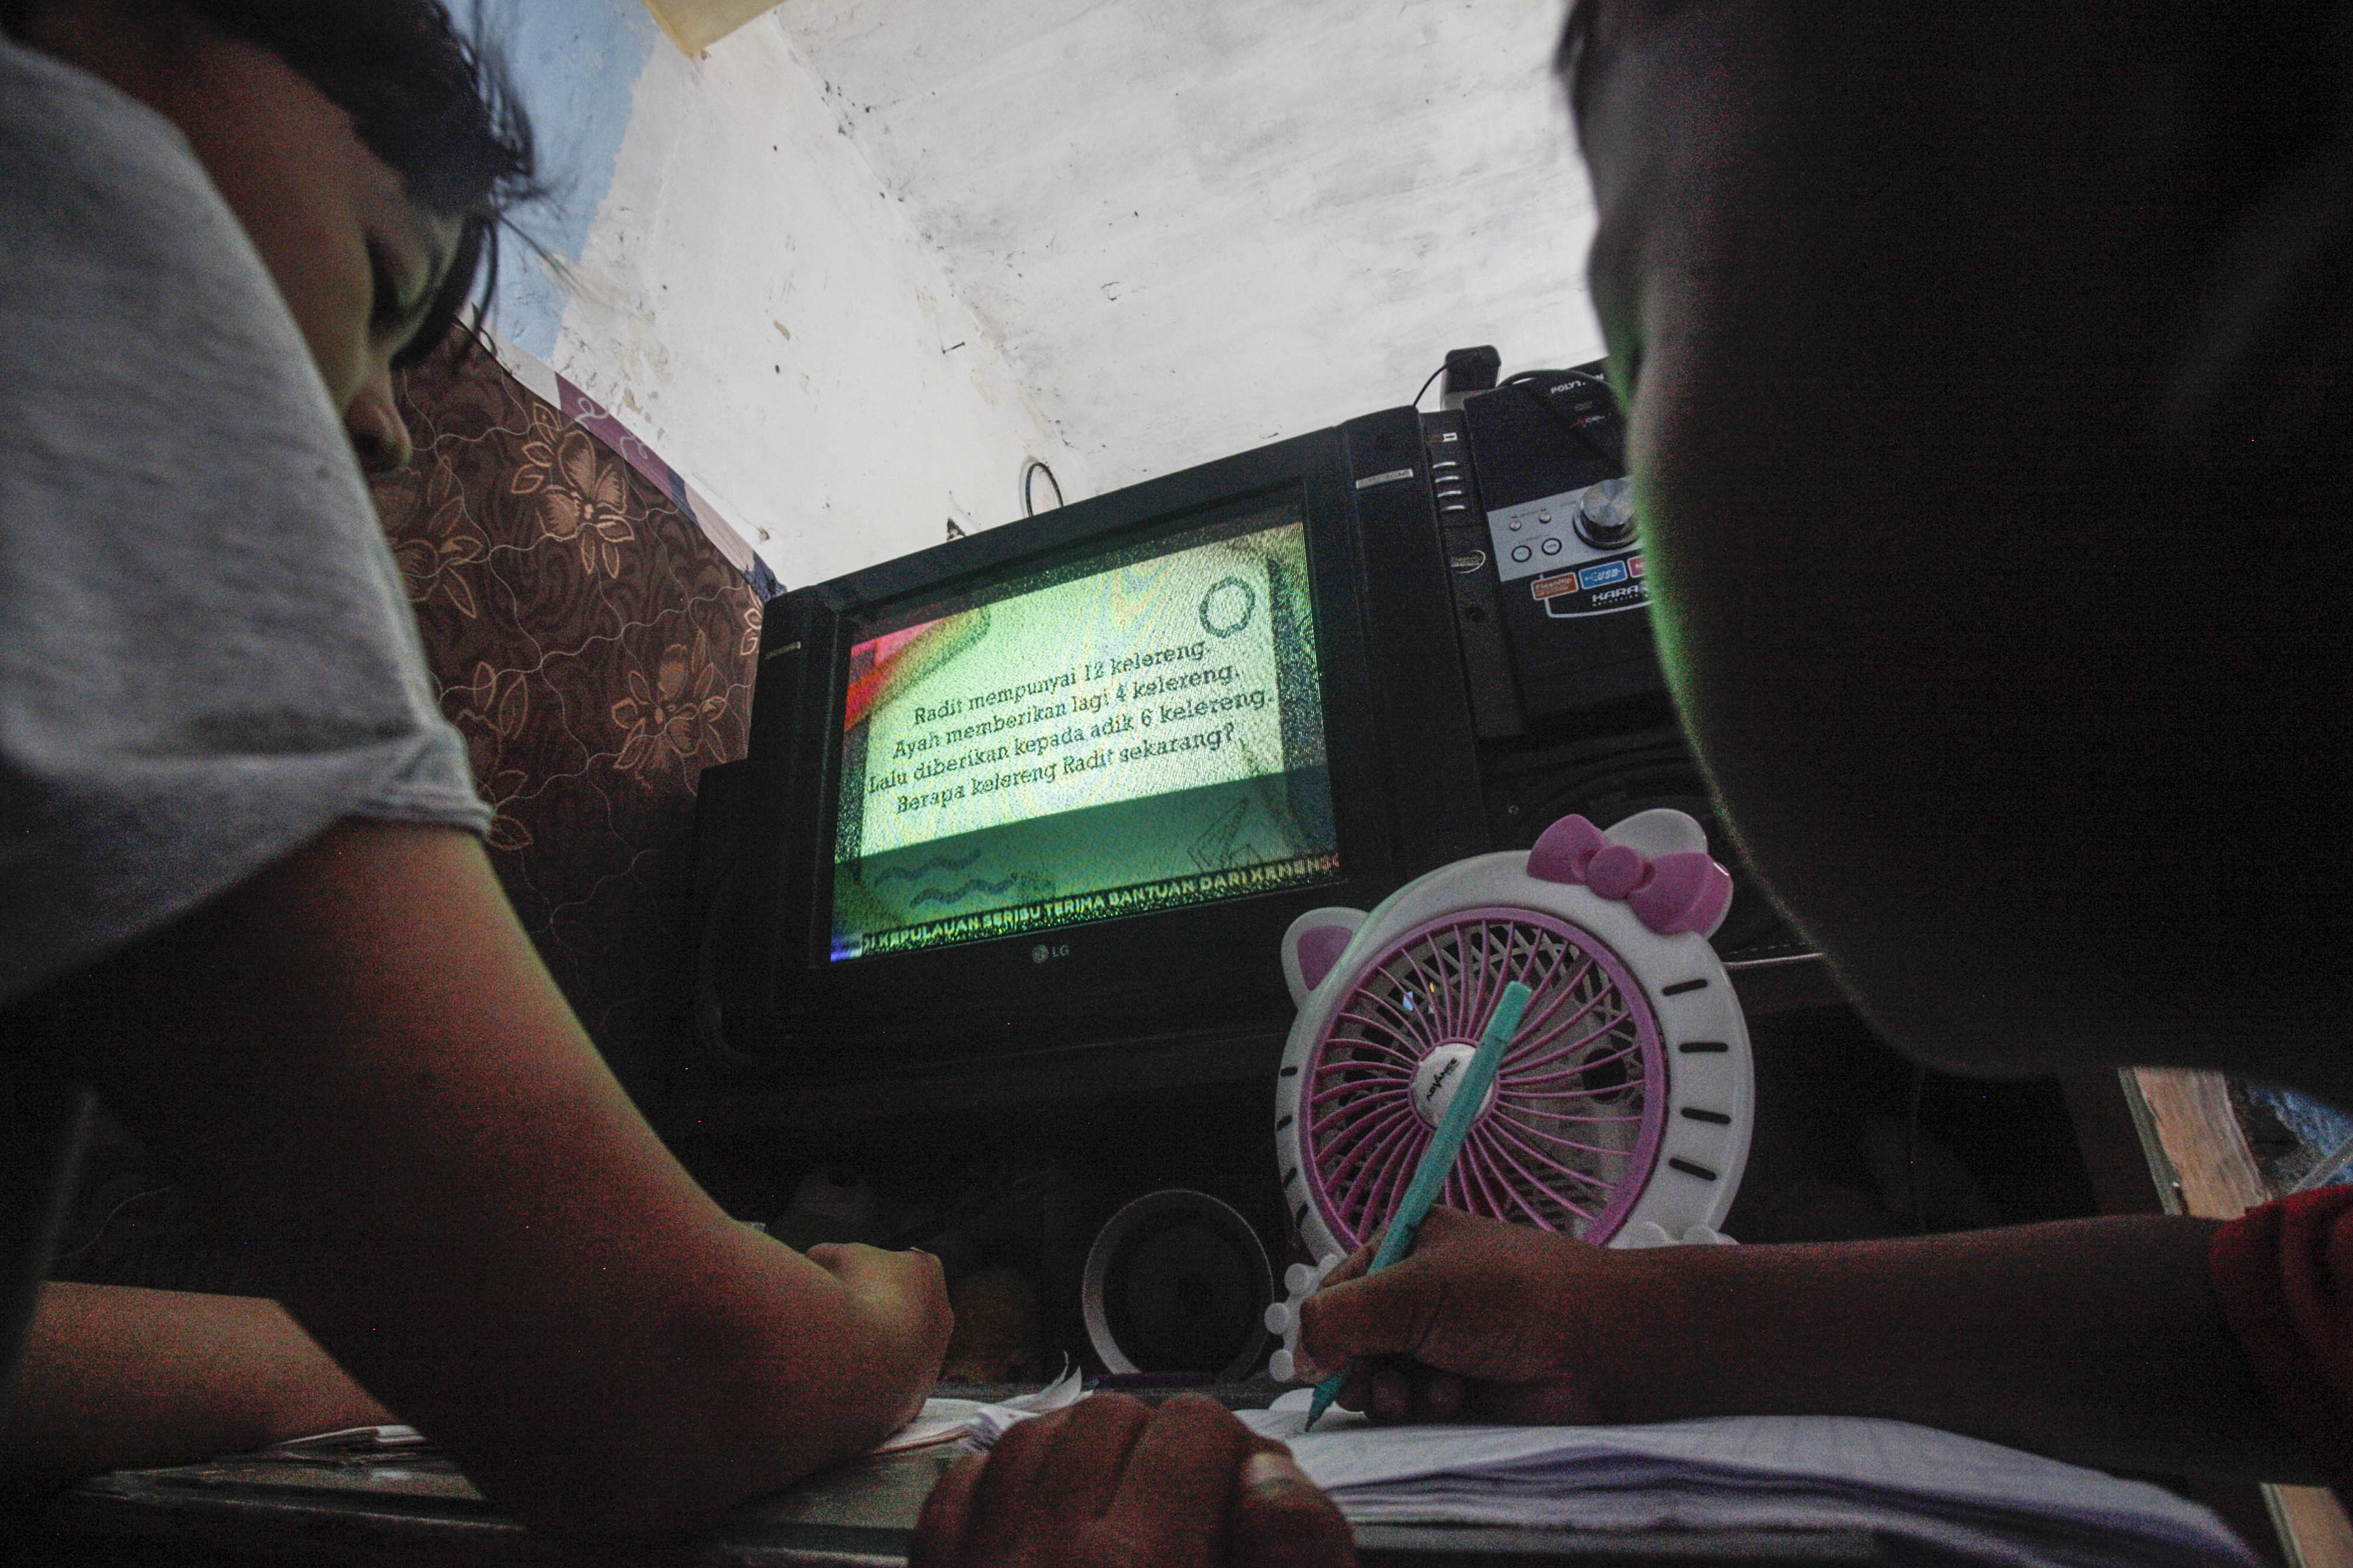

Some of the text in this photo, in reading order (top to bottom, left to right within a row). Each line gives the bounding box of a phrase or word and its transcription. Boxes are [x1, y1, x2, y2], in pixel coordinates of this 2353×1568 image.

[1598, 568, 1618, 581] USB
[892, 732, 940, 759] Ayah
[946, 702, 1066, 745] memberikan
[1071, 688, 1109, 713] lagi
[1116, 682, 1127, 702] 4
[914, 699, 962, 725] Radit
[968, 668, 1076, 710] mempunyai
[1085, 660, 1104, 680] 12
[868, 770, 907, 793] Lalu
[914, 745, 1009, 780] diberikan
[1014, 726, 1085, 756] kepada
[1091, 712, 1134, 738] adik
[1141, 709, 1152, 728] 6
[896, 722, 1234, 814] Berapa kelereng Radit sekarang?
[879, 918, 979, 947] KEPULAUAN
[982, 906, 1041, 928] SERIBU
[1044, 895, 1105, 918] TERIMA
[1108, 880, 1194, 907] BANTUAN
[1199, 870, 1248, 890] DARI
[1052, 945, 1069, 958] LG
